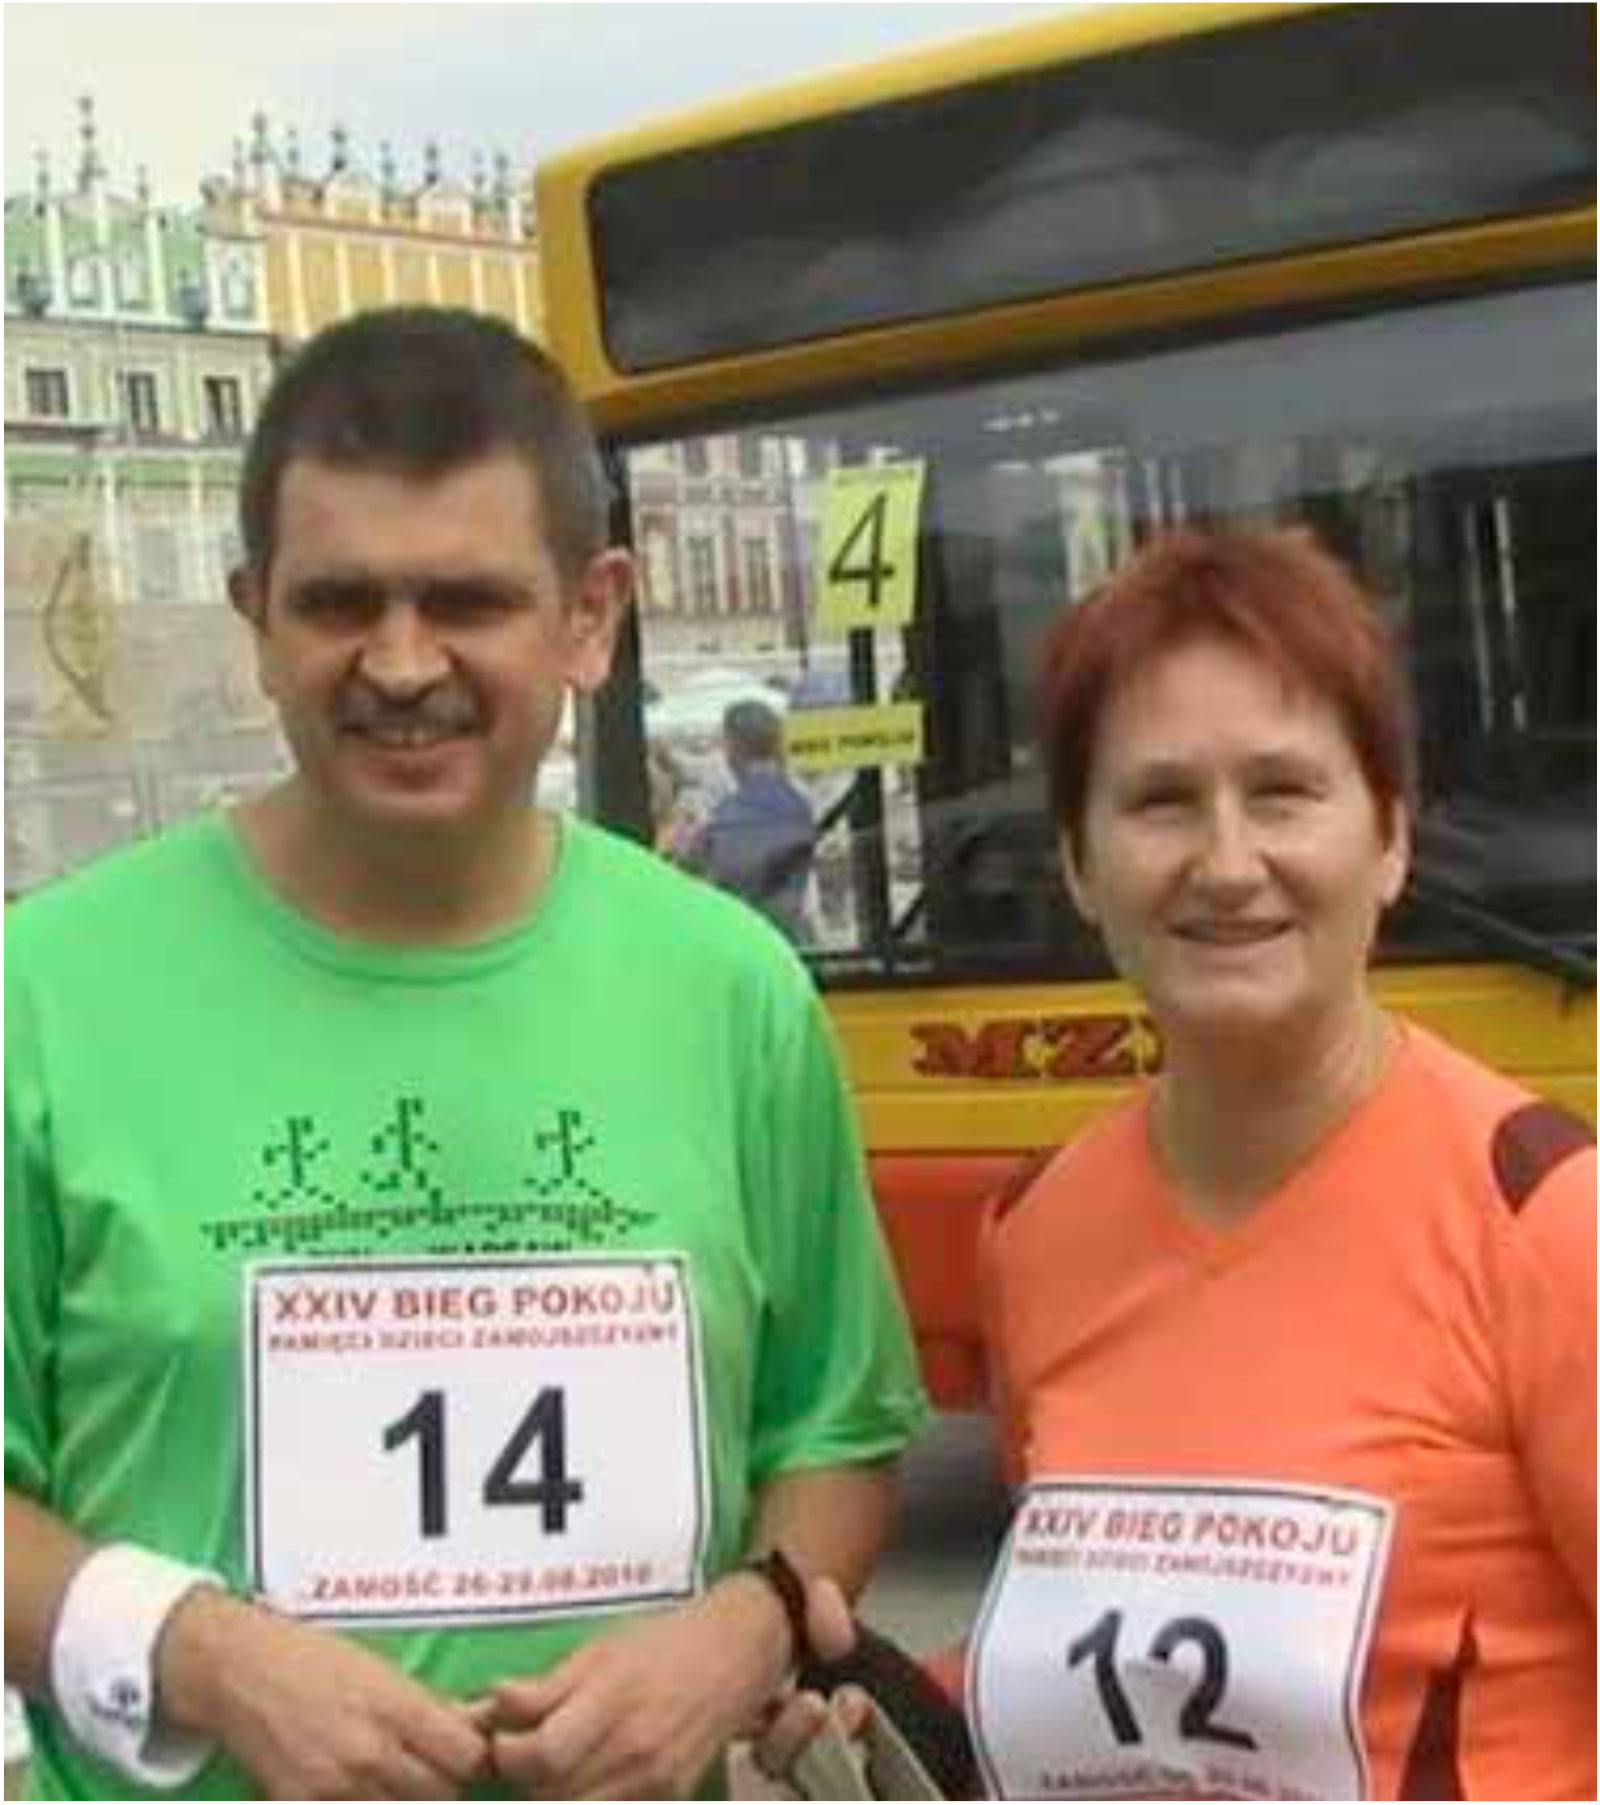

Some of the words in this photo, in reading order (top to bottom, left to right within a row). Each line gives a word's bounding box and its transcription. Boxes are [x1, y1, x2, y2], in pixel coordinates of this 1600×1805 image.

[829, 492, 896, 607] 4
[274, 1289, 377, 1321] XXIV
[392, 1287, 497, 1319] BIEG
[513, 1282, 676, 1315] POKOJU
[382, 1386, 584, 1539] 14
[1022, 1508, 1098, 1540] XXIV
[1103, 1511, 1183, 1543] BIEG
[1192, 1513, 1360, 1555] POKOJU
[1067, 1610, 1261, 1751] 12
